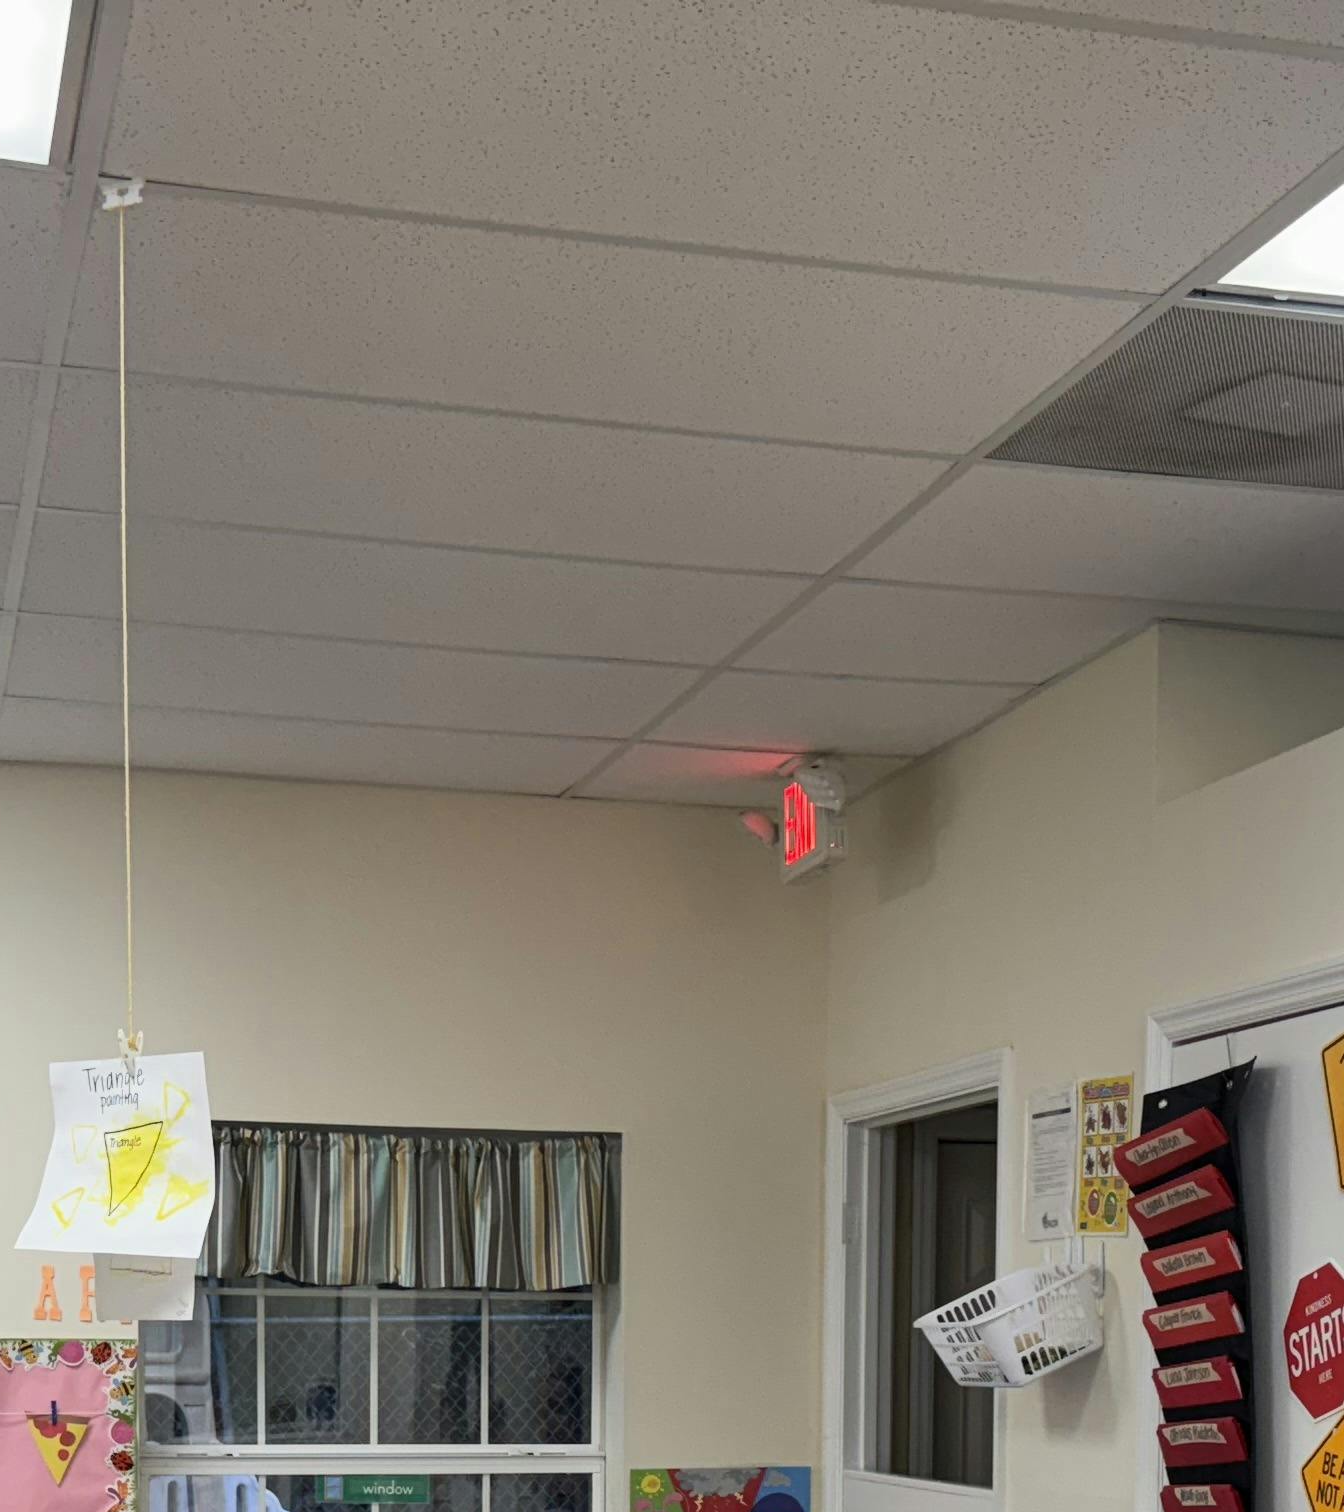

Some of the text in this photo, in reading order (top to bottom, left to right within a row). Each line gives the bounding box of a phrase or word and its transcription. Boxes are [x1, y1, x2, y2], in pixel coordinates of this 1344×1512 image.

[1318, 1368, 1334, 1385] HERE
[1322, 1451, 1338, 1478] BE
[362, 1482, 414, 1496] window
[1316, 1480, 1340, 1509] NOT
